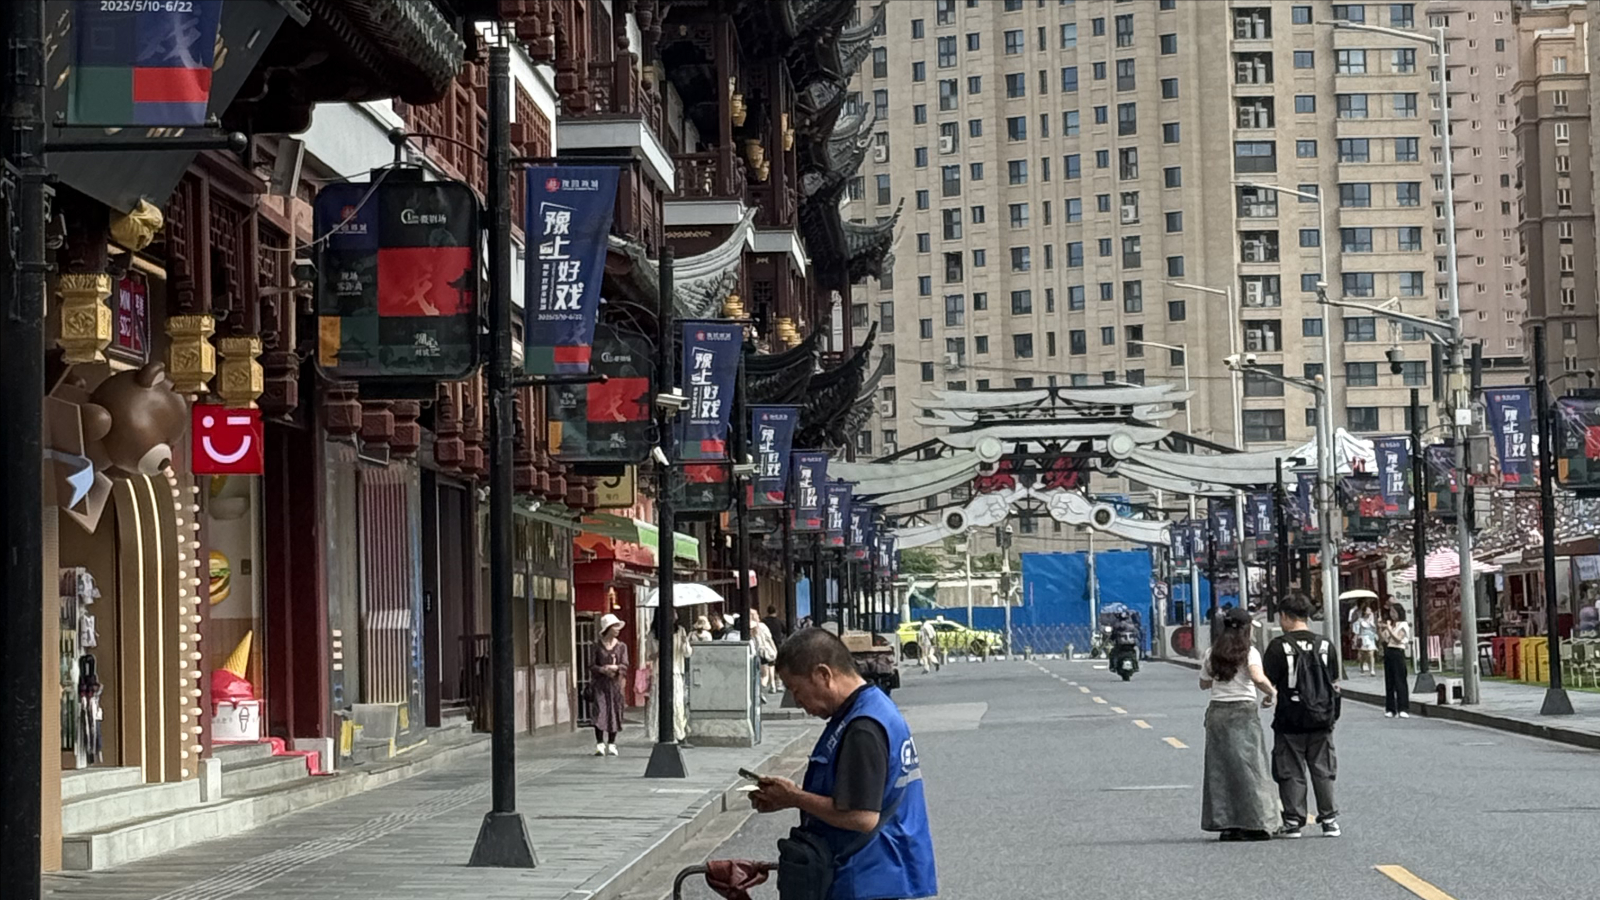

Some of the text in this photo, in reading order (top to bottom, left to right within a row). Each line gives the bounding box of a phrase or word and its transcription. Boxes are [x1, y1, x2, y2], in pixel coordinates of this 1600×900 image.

[100, 0, 193, 12] 2025/5/10-6/22
[539, 210, 585, 311] 豫上好戏
[691, 352, 721, 418] 豫上好戏
